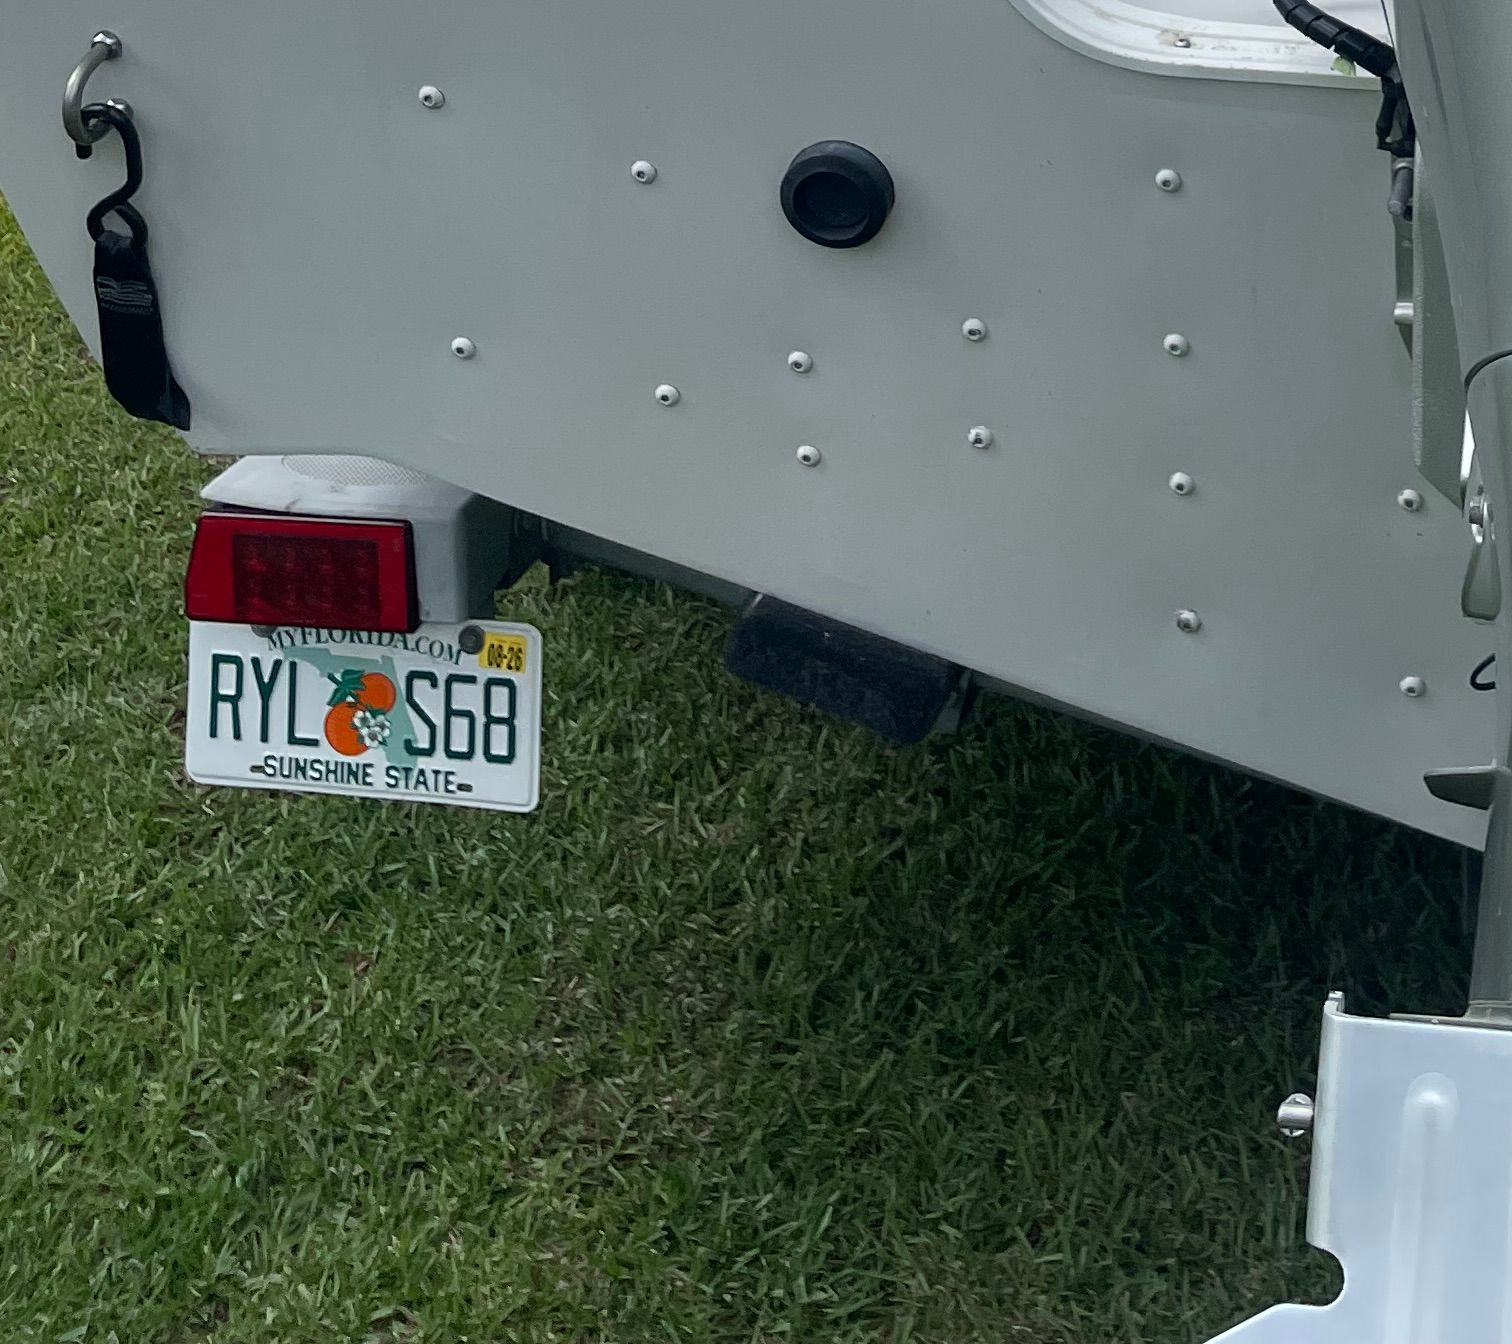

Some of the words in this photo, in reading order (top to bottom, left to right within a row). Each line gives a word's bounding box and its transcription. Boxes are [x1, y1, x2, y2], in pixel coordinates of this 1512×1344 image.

[209, 653, 319, 747] RYL
[404, 670, 517, 763] S68
[263, 754, 374, 787] SUNSHINE
[384, 764, 458, 794] STATE
